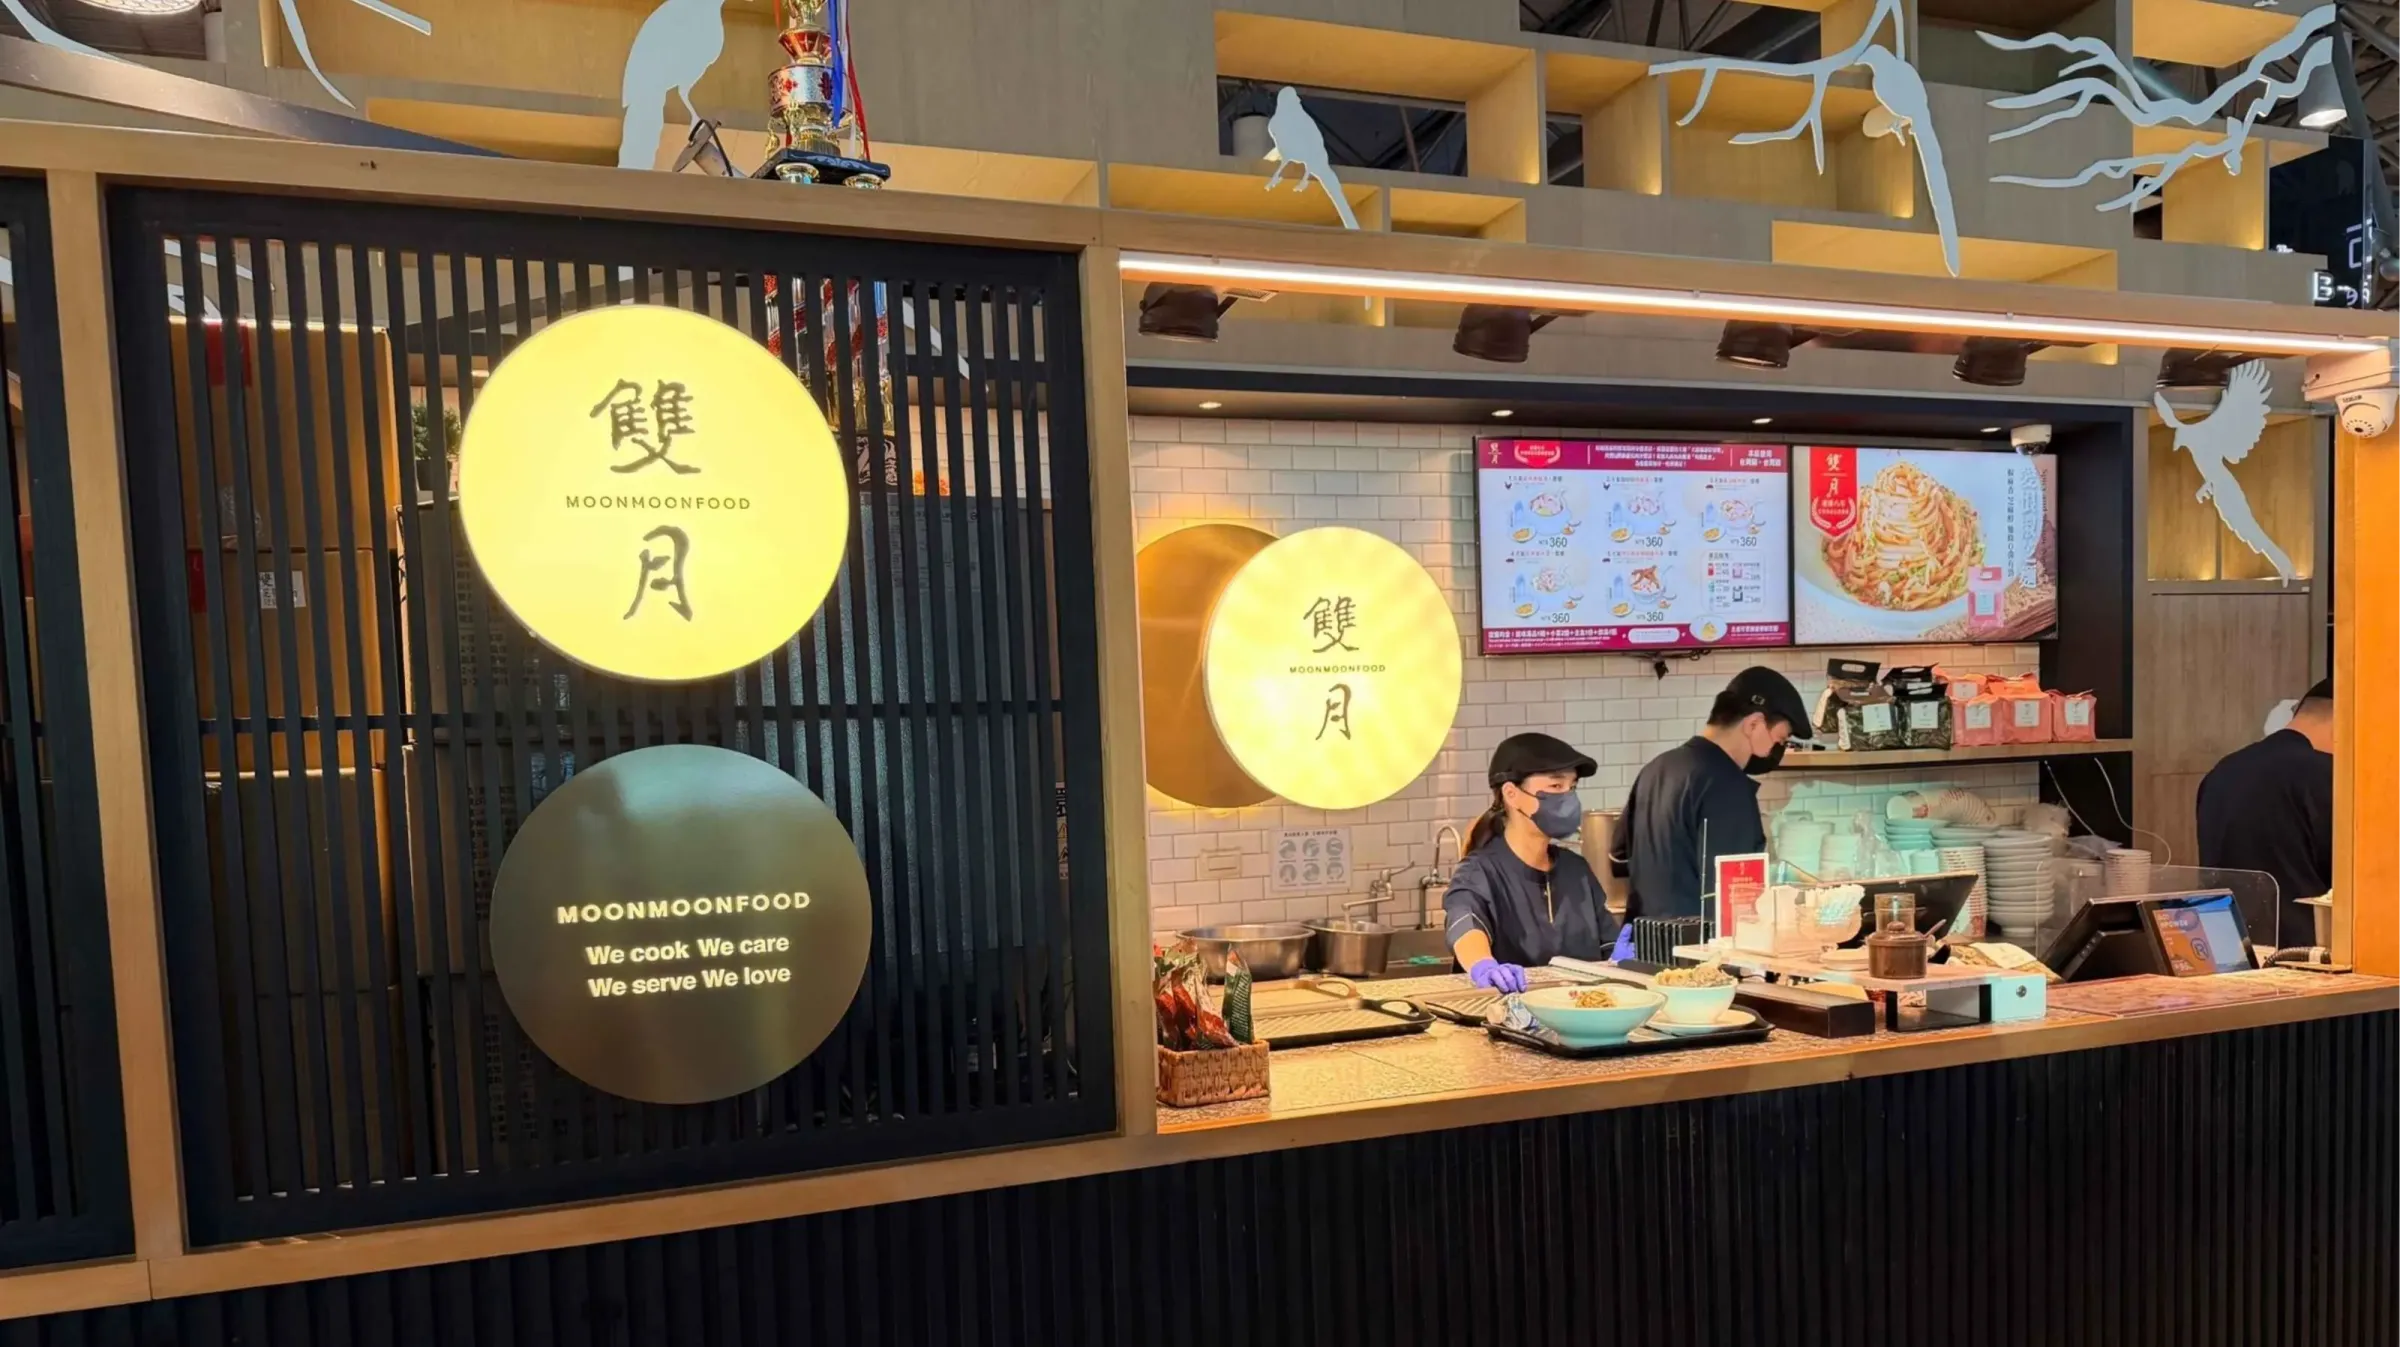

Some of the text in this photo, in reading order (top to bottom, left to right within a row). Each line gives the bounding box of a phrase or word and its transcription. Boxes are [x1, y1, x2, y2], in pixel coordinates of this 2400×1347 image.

[588, 377, 702, 475] 雙
[565, 495, 751, 510] MOONMOONFOOD
[1549, 536, 1568, 548] 360
[1645, 536, 1663, 548] 360
[1740, 536, 1757, 547] 360
[621, 524, 693, 622] 月
[1302, 595, 1360, 654] 雙
[1551, 612, 1570, 624] 360
[1646, 611, 1664, 622] 360
[1289, 664, 1386, 674] MOONMOONFOOD
[1315, 683, 1352, 741] 月
[557, 892, 810, 924] MOONMOONFOOD
[585, 936, 790, 965] We cook We care
[587, 966, 791, 998] We serve We love
